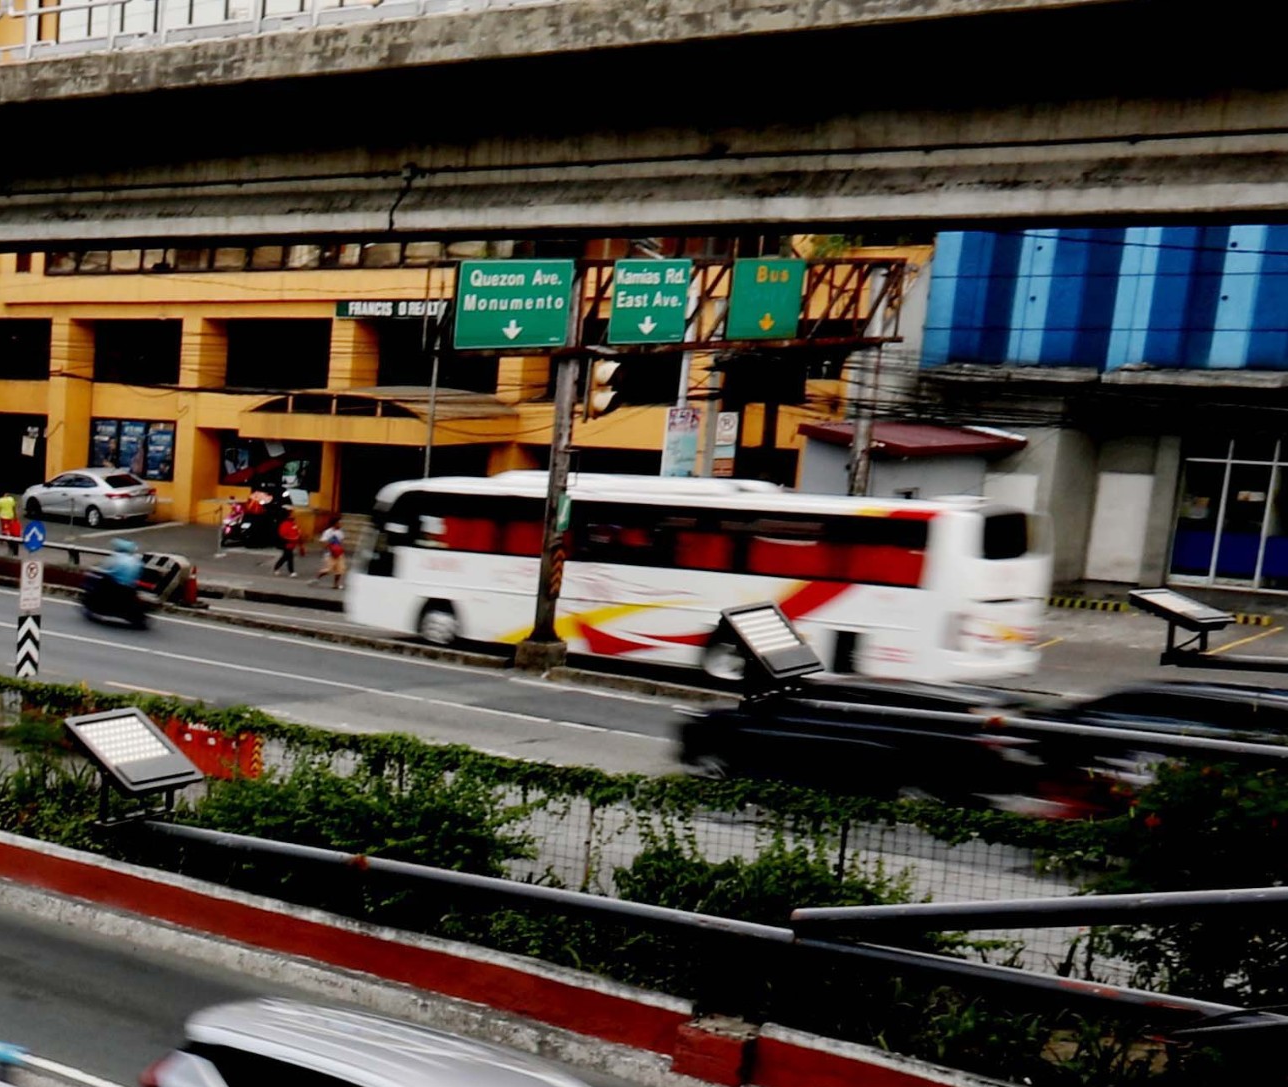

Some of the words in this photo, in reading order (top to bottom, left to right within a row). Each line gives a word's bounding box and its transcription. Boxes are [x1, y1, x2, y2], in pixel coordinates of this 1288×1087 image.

[470, 269, 526, 287] Quezon
[532, 268, 563, 286] Ave.
[616, 267, 661, 285] Kamias
[664, 267, 687, 285] Rd.
[756, 264, 790, 283] Bus
[348, 301, 393, 316] FRANCIS
[463, 293, 565, 311] Monumento
[616, 290, 649, 309] East
[652, 290, 683, 308] Ave.
